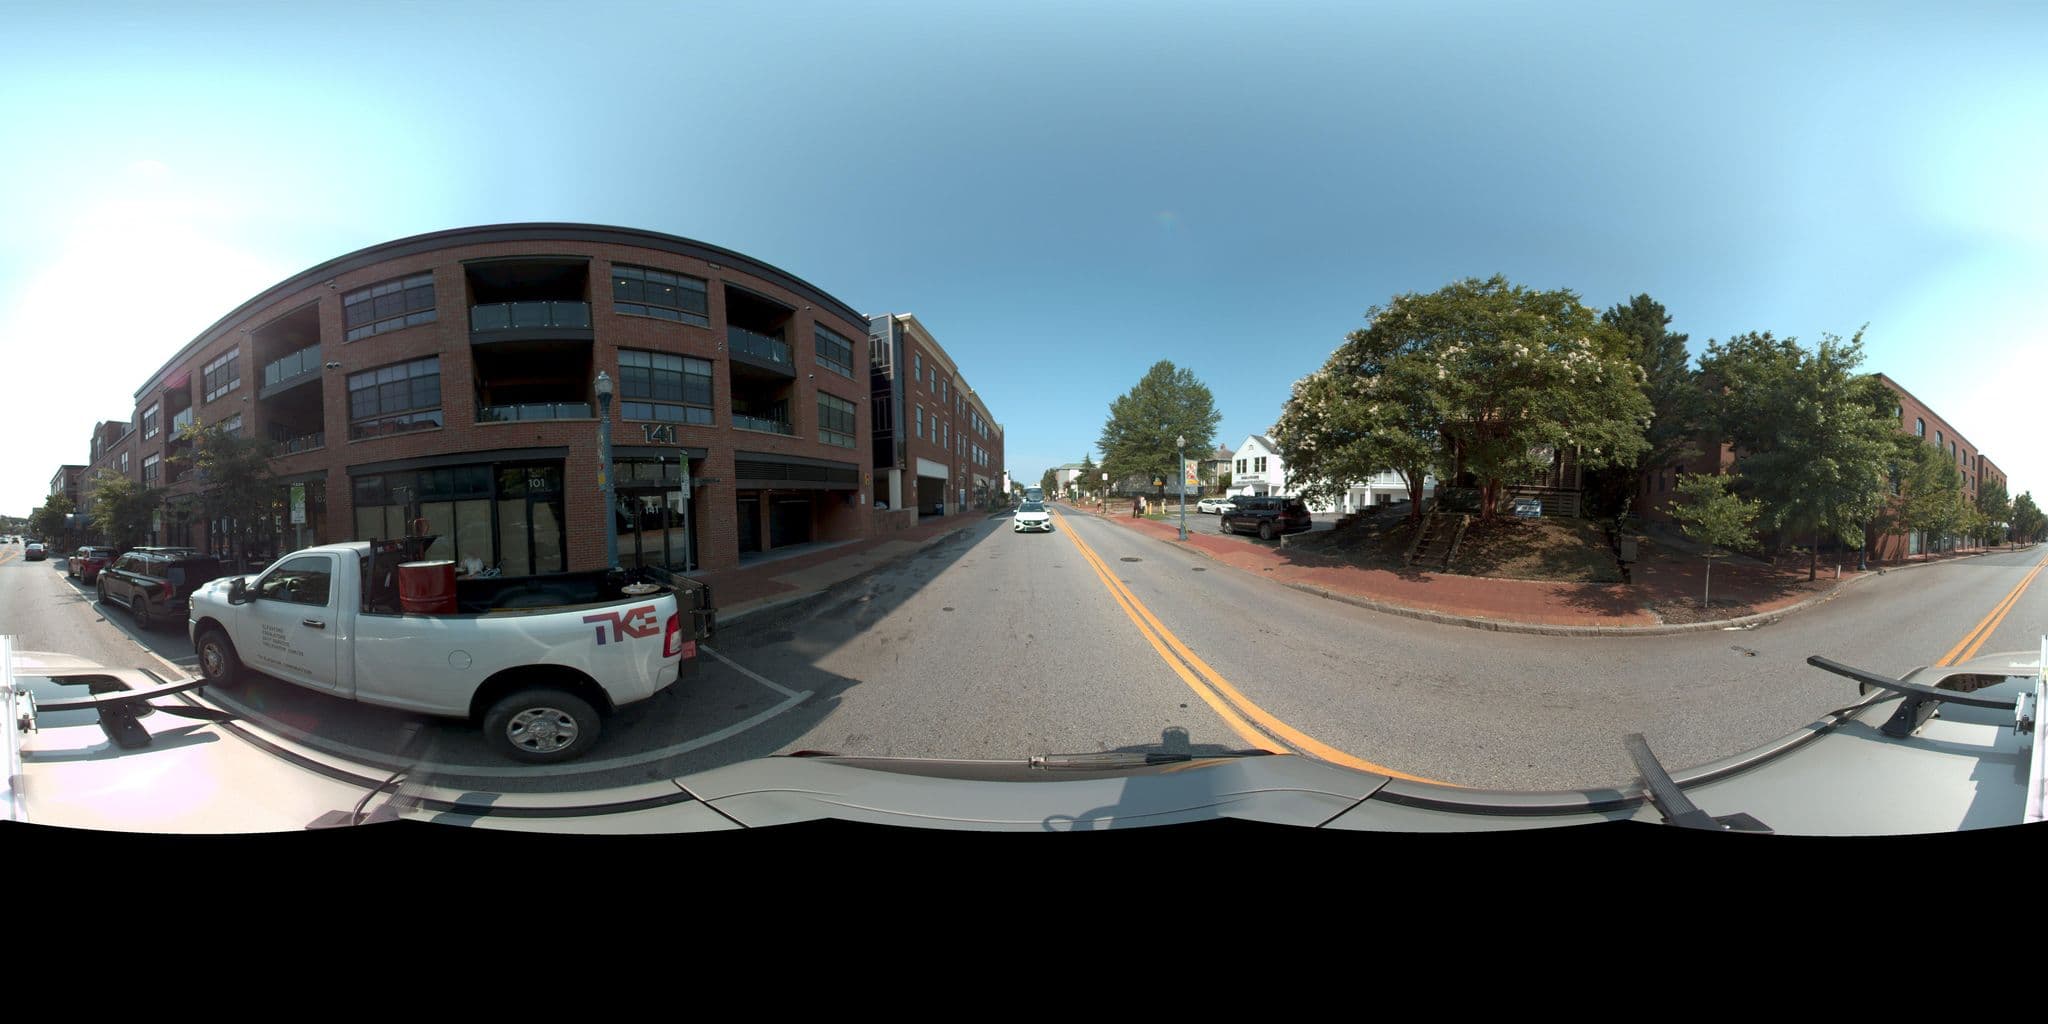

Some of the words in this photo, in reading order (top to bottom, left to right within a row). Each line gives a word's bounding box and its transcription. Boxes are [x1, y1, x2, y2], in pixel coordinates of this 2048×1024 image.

[641, 424, 676, 444] 141
[528, 478, 545, 488] 101
[583, 605, 660, 645] TKE
